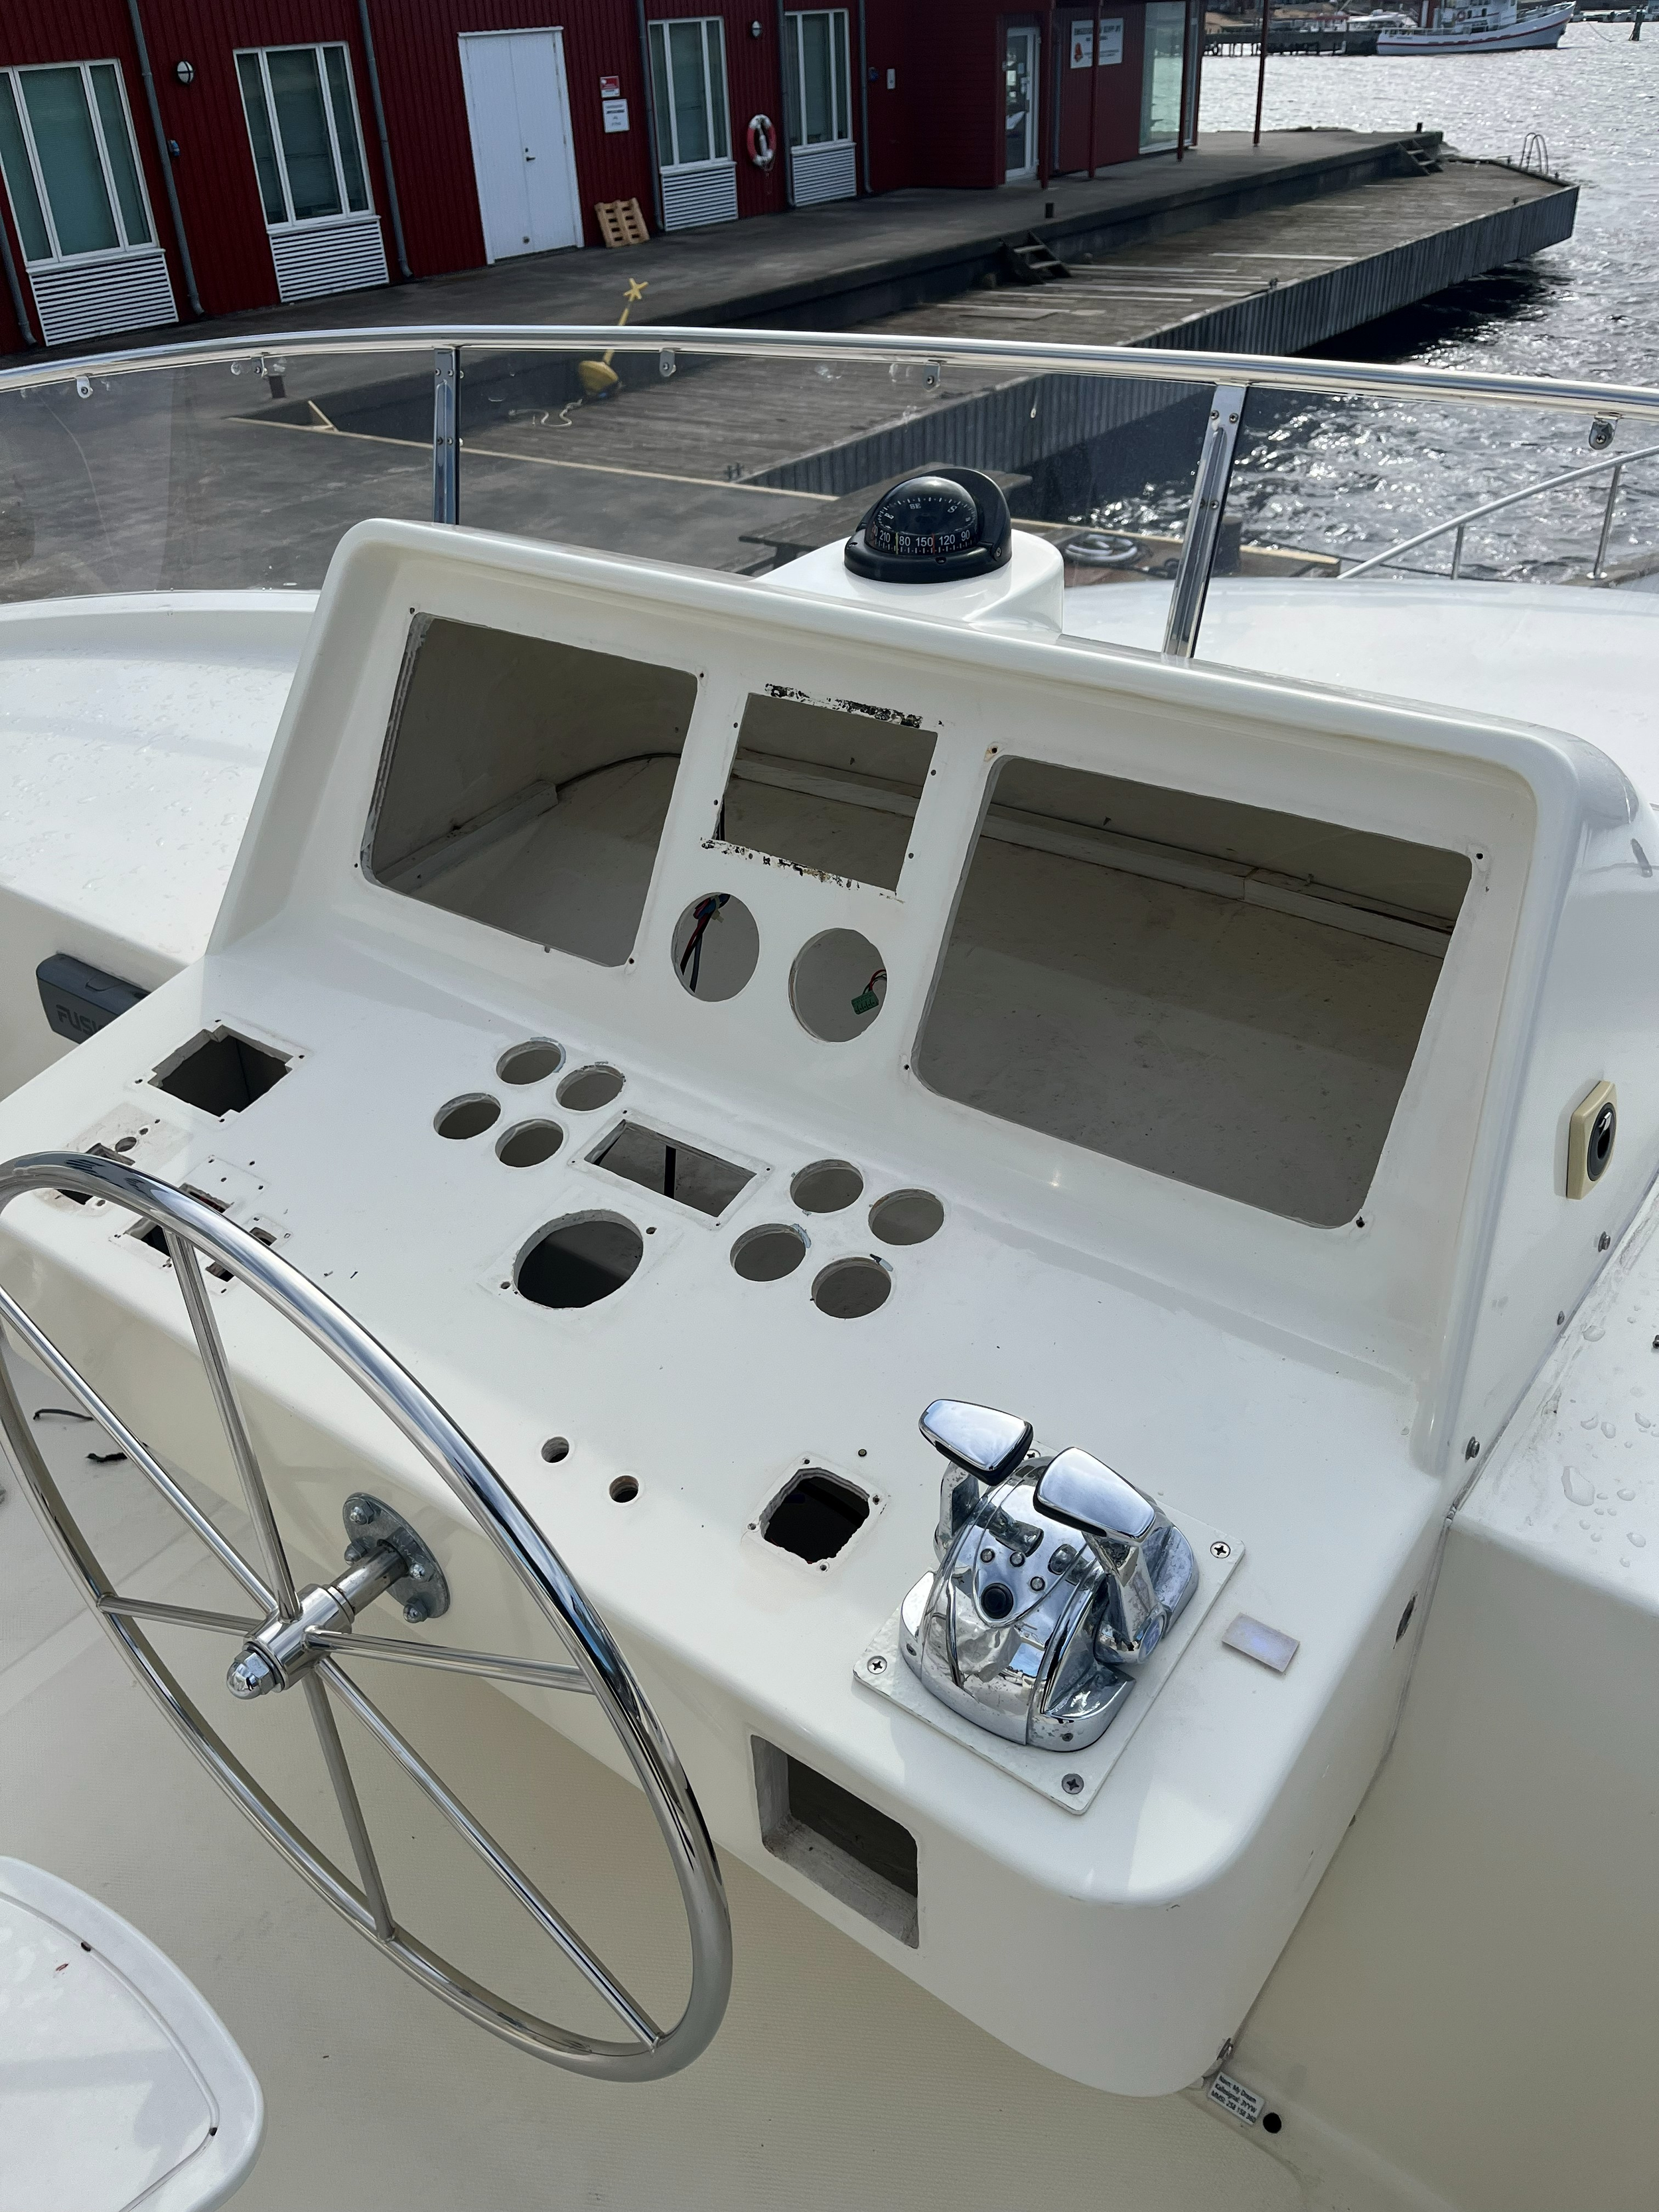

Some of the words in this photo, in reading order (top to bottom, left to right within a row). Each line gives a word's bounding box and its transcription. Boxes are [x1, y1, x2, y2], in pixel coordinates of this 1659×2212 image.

[879, 530, 891, 543] 210
[896, 536, 911, 546] 80
[916, 537, 933, 547] 150
[939, 534, 956, 546] 120
[961, 530, 970, 542] 90
[56, 1003, 103, 1036] FUSI
